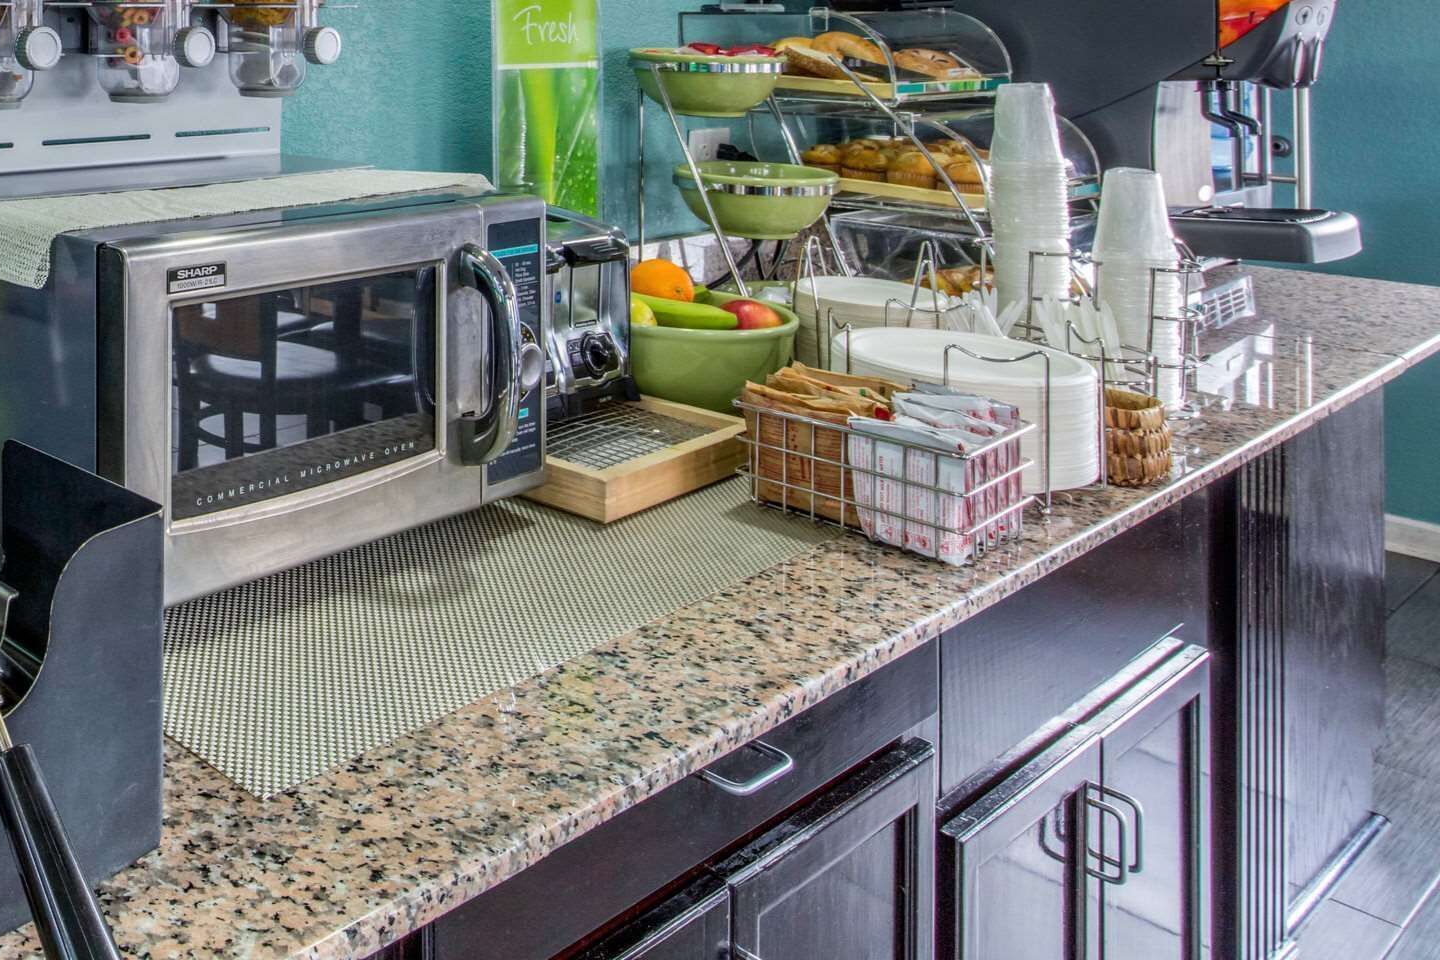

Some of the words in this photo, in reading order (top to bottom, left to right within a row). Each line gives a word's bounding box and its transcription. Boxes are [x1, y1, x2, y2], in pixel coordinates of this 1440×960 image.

[513, 5, 578, 45] Fresh
[177, 265, 217, 279] SHARP
[196, 475, 289, 506] COMMERCIAL
[300, 451, 375, 478] MICROWAVE
[384, 441, 414, 456] OVEN
